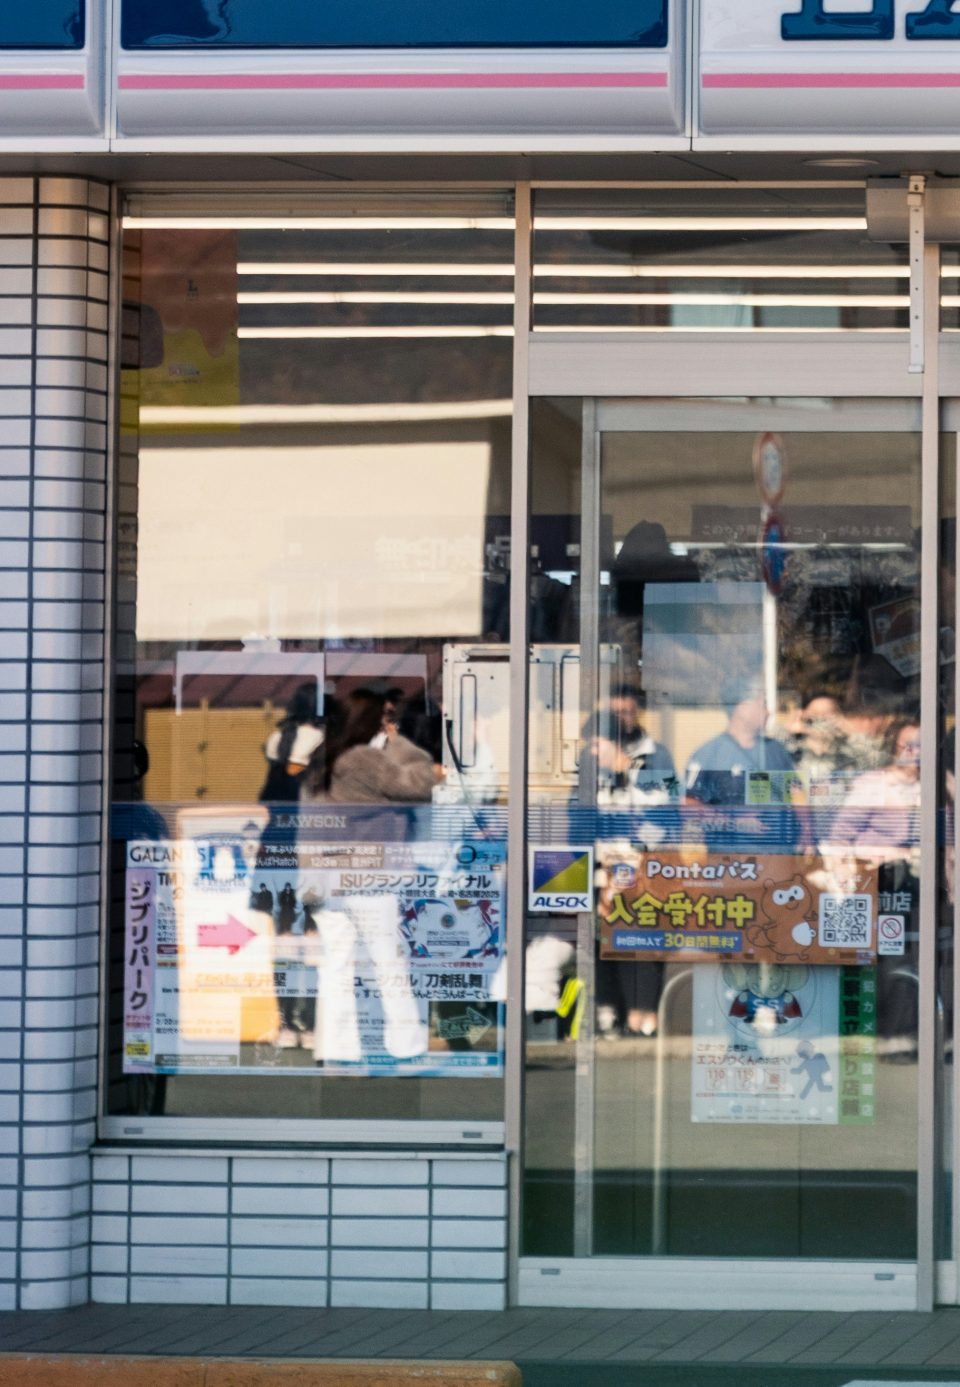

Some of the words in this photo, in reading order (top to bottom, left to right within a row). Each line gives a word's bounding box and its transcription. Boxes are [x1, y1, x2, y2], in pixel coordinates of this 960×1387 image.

[275, 814, 347, 829] LAWSON
[129, 846, 206, 863] GALANS
[647, 860, 759, 880] Pontaパス
[533, 896, 588, 908] ALSOK
[604, 891, 755, 928] 入会受付中
[129, 879, 152, 1011] ジブリパーク
